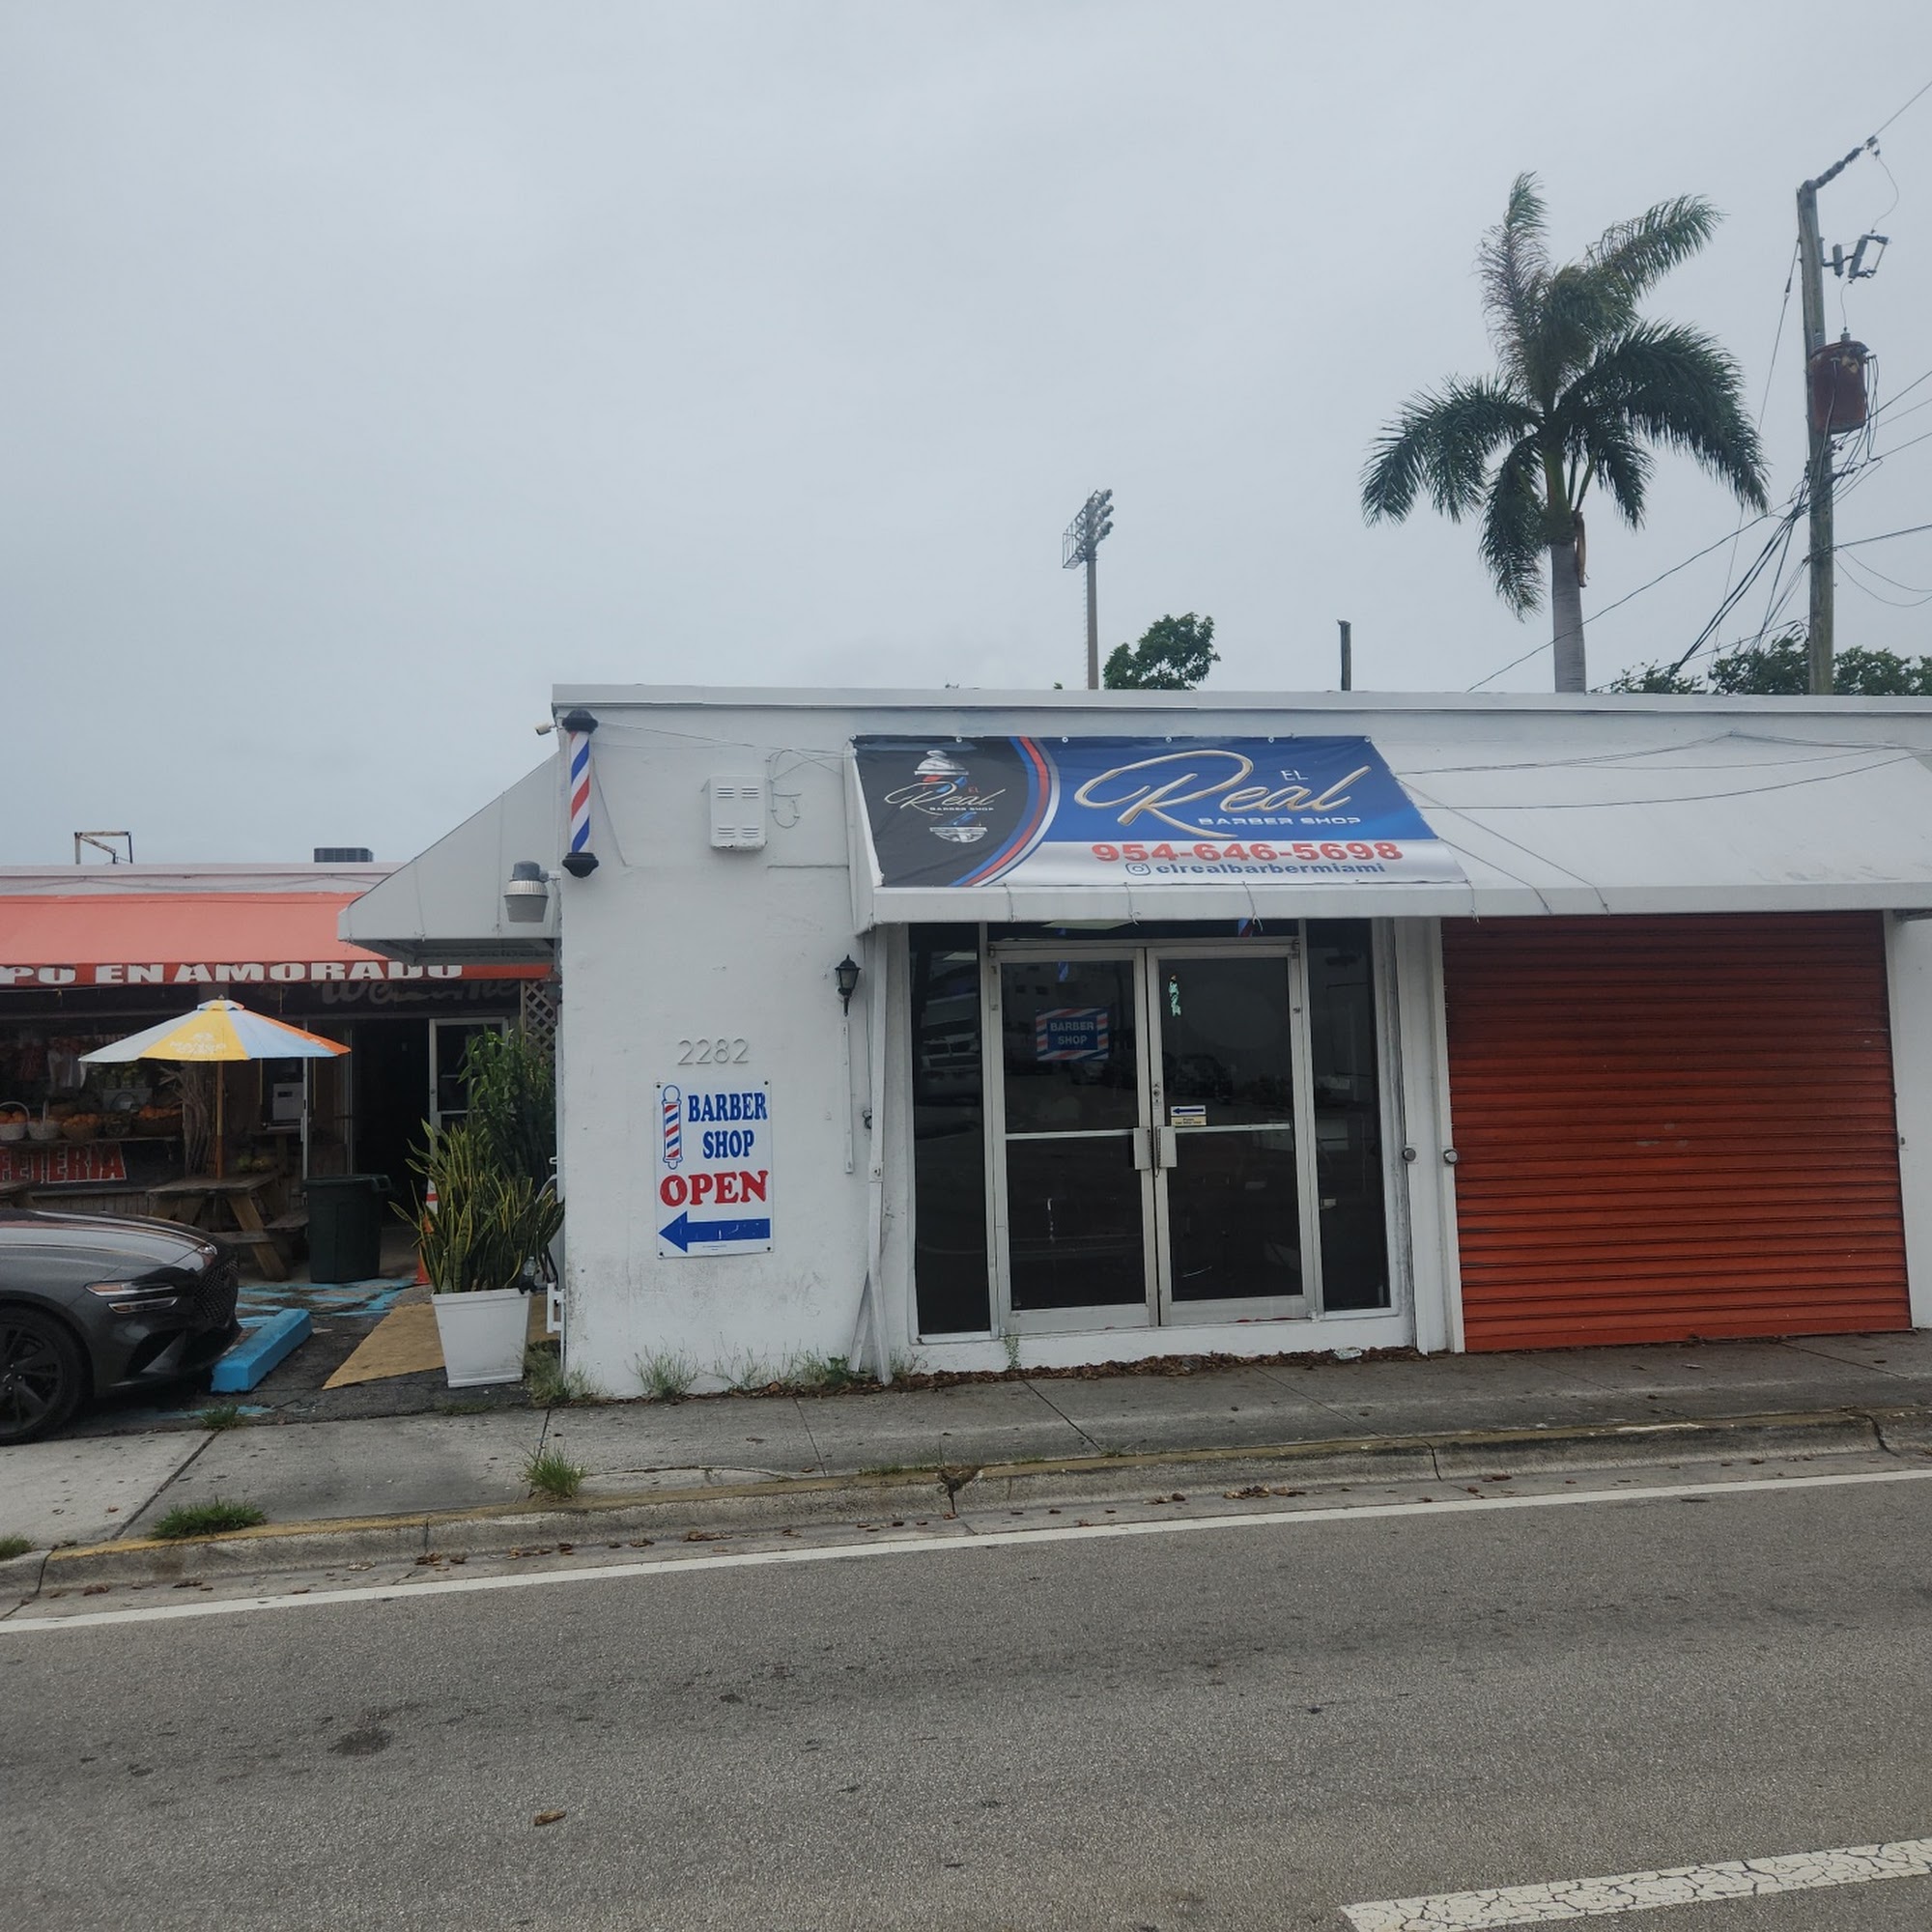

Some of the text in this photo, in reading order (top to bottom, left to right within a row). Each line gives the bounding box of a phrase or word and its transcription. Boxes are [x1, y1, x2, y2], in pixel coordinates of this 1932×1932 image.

[1281, 770, 1309, 781] EL
[884, 781, 1006, 816] Real
[1073, 750, 1372, 839] Real
[1198, 816, 1362, 826] BARBER SHOP
[1091, 842, 1404, 862] 954-646-5698
[1155, 862, 1386, 875] elrealbarbermiami
[1050, 1021, 1094, 1032] BARBER
[677, 1037, 750, 1065] 2282
[1058, 1035, 1088, 1045] SHOP
[687, 1092, 769, 1122] BARBER
[702, 1129, 755, 1160] SHOP
[659, 1170, 769, 1208] OPEN
